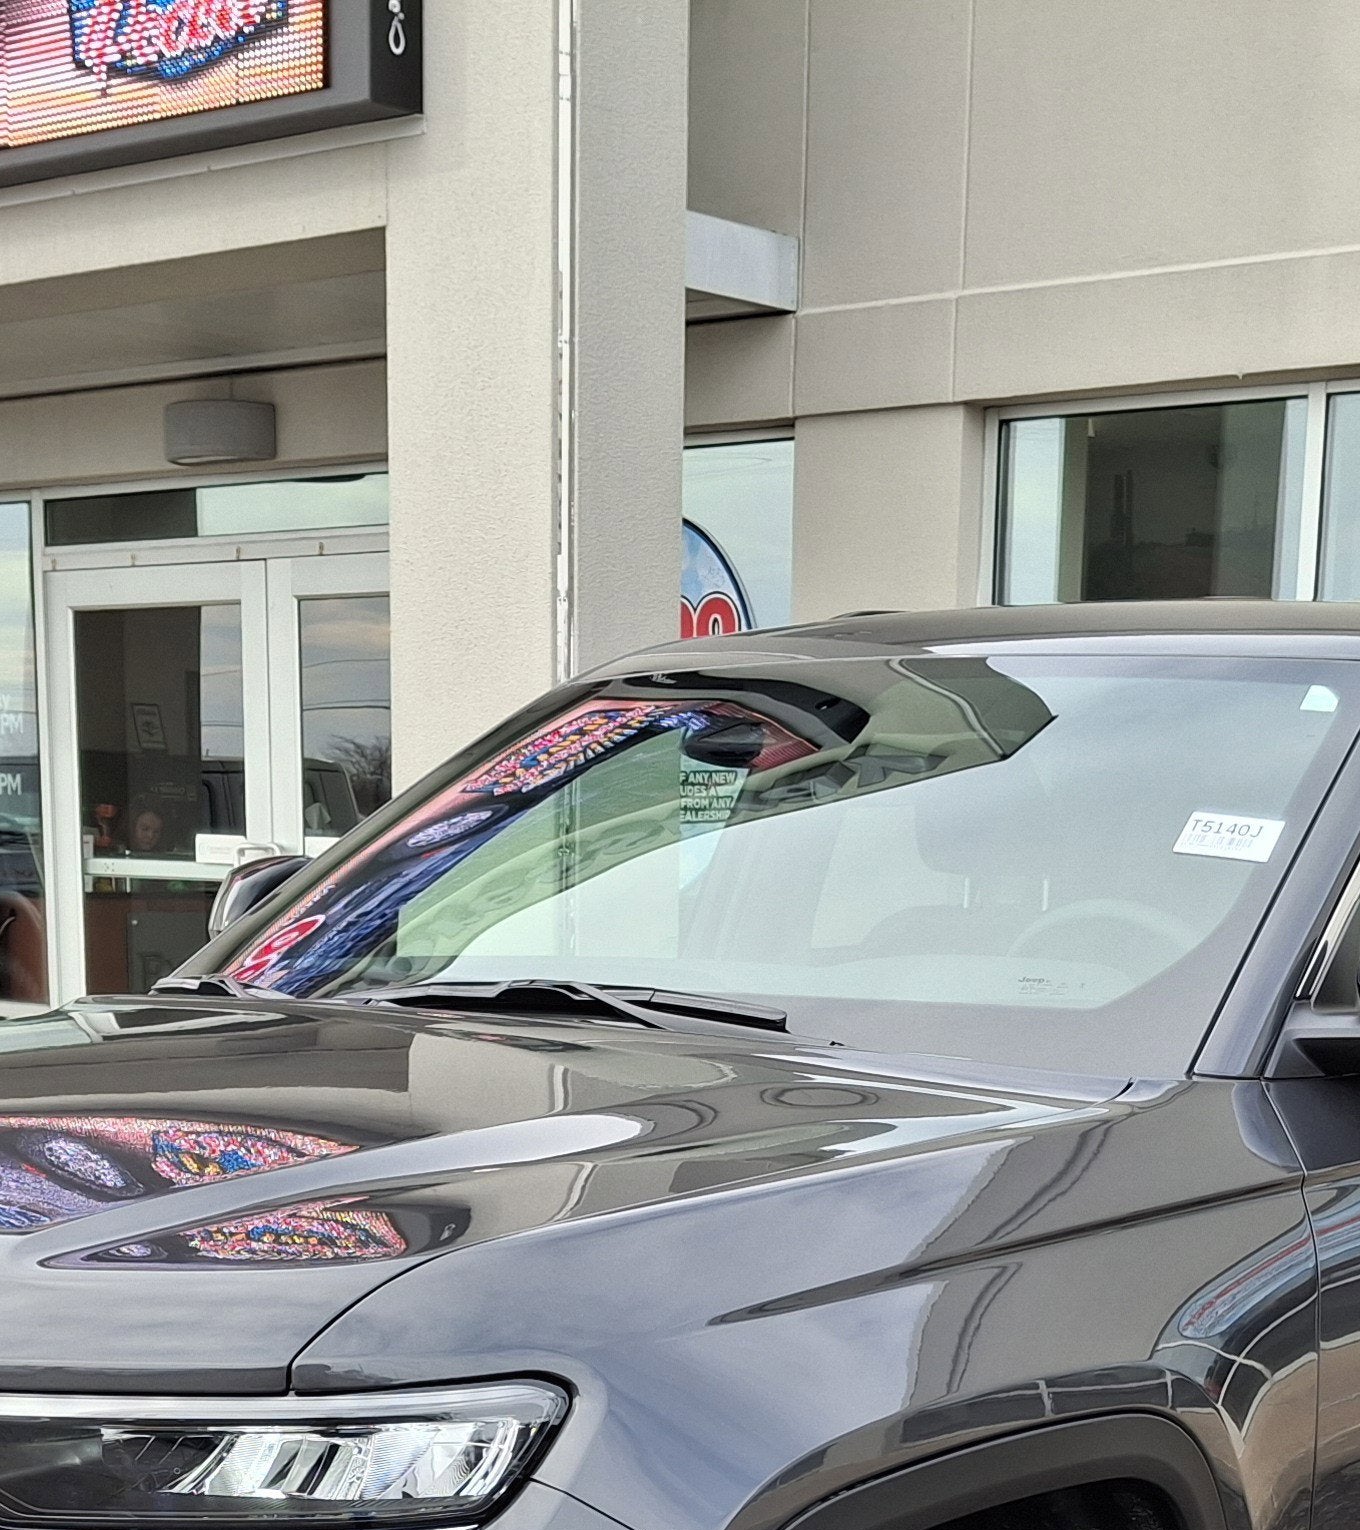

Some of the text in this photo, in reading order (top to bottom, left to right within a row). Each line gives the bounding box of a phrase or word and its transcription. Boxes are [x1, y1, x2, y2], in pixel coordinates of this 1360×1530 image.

[711, 772, 736, 784] NEW
[680, 797, 709, 809] FROM
[1191, 819, 1264, 838] T5140J
